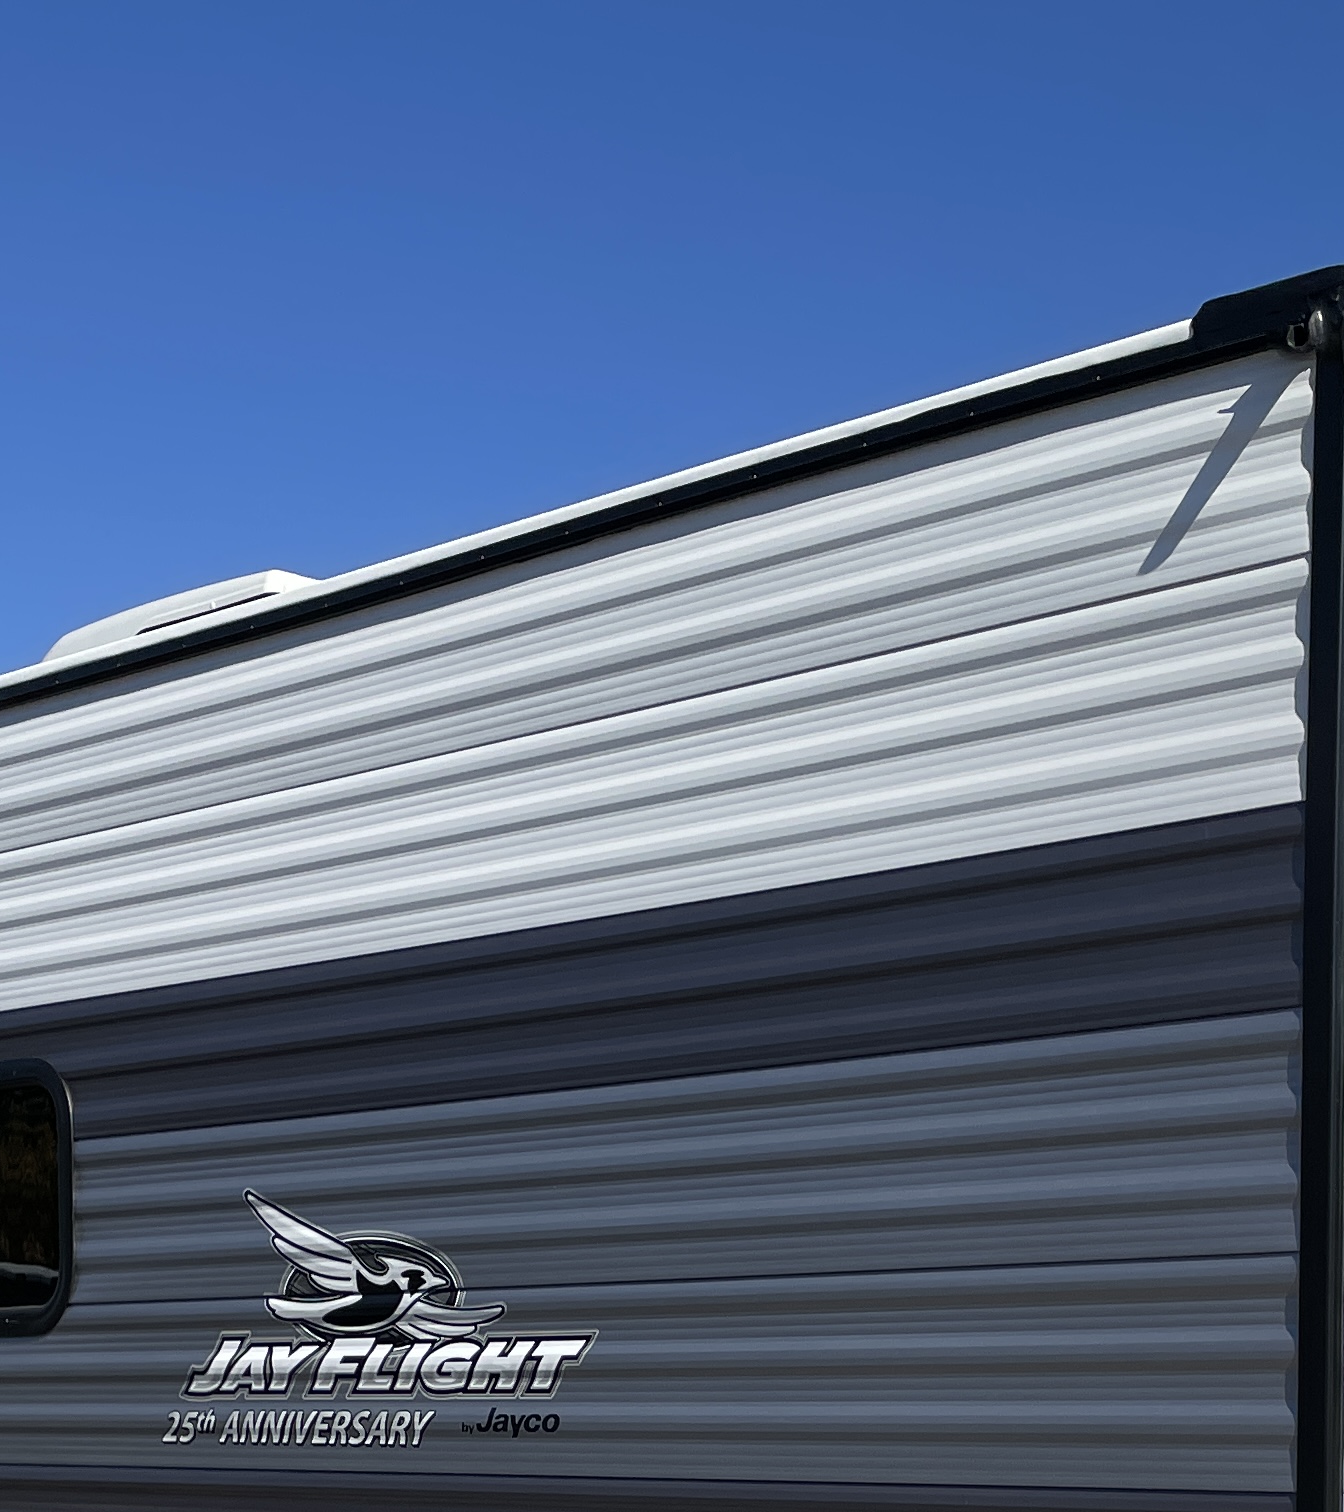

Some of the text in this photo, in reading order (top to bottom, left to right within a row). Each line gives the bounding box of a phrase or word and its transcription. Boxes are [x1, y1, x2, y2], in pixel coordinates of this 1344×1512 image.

[184, 1332, 595, 1398] JAY FLIGHT
[162, 1409, 437, 1448] 25th ANNIVERSARY
[461, 1407, 561, 1438] by Jayco
